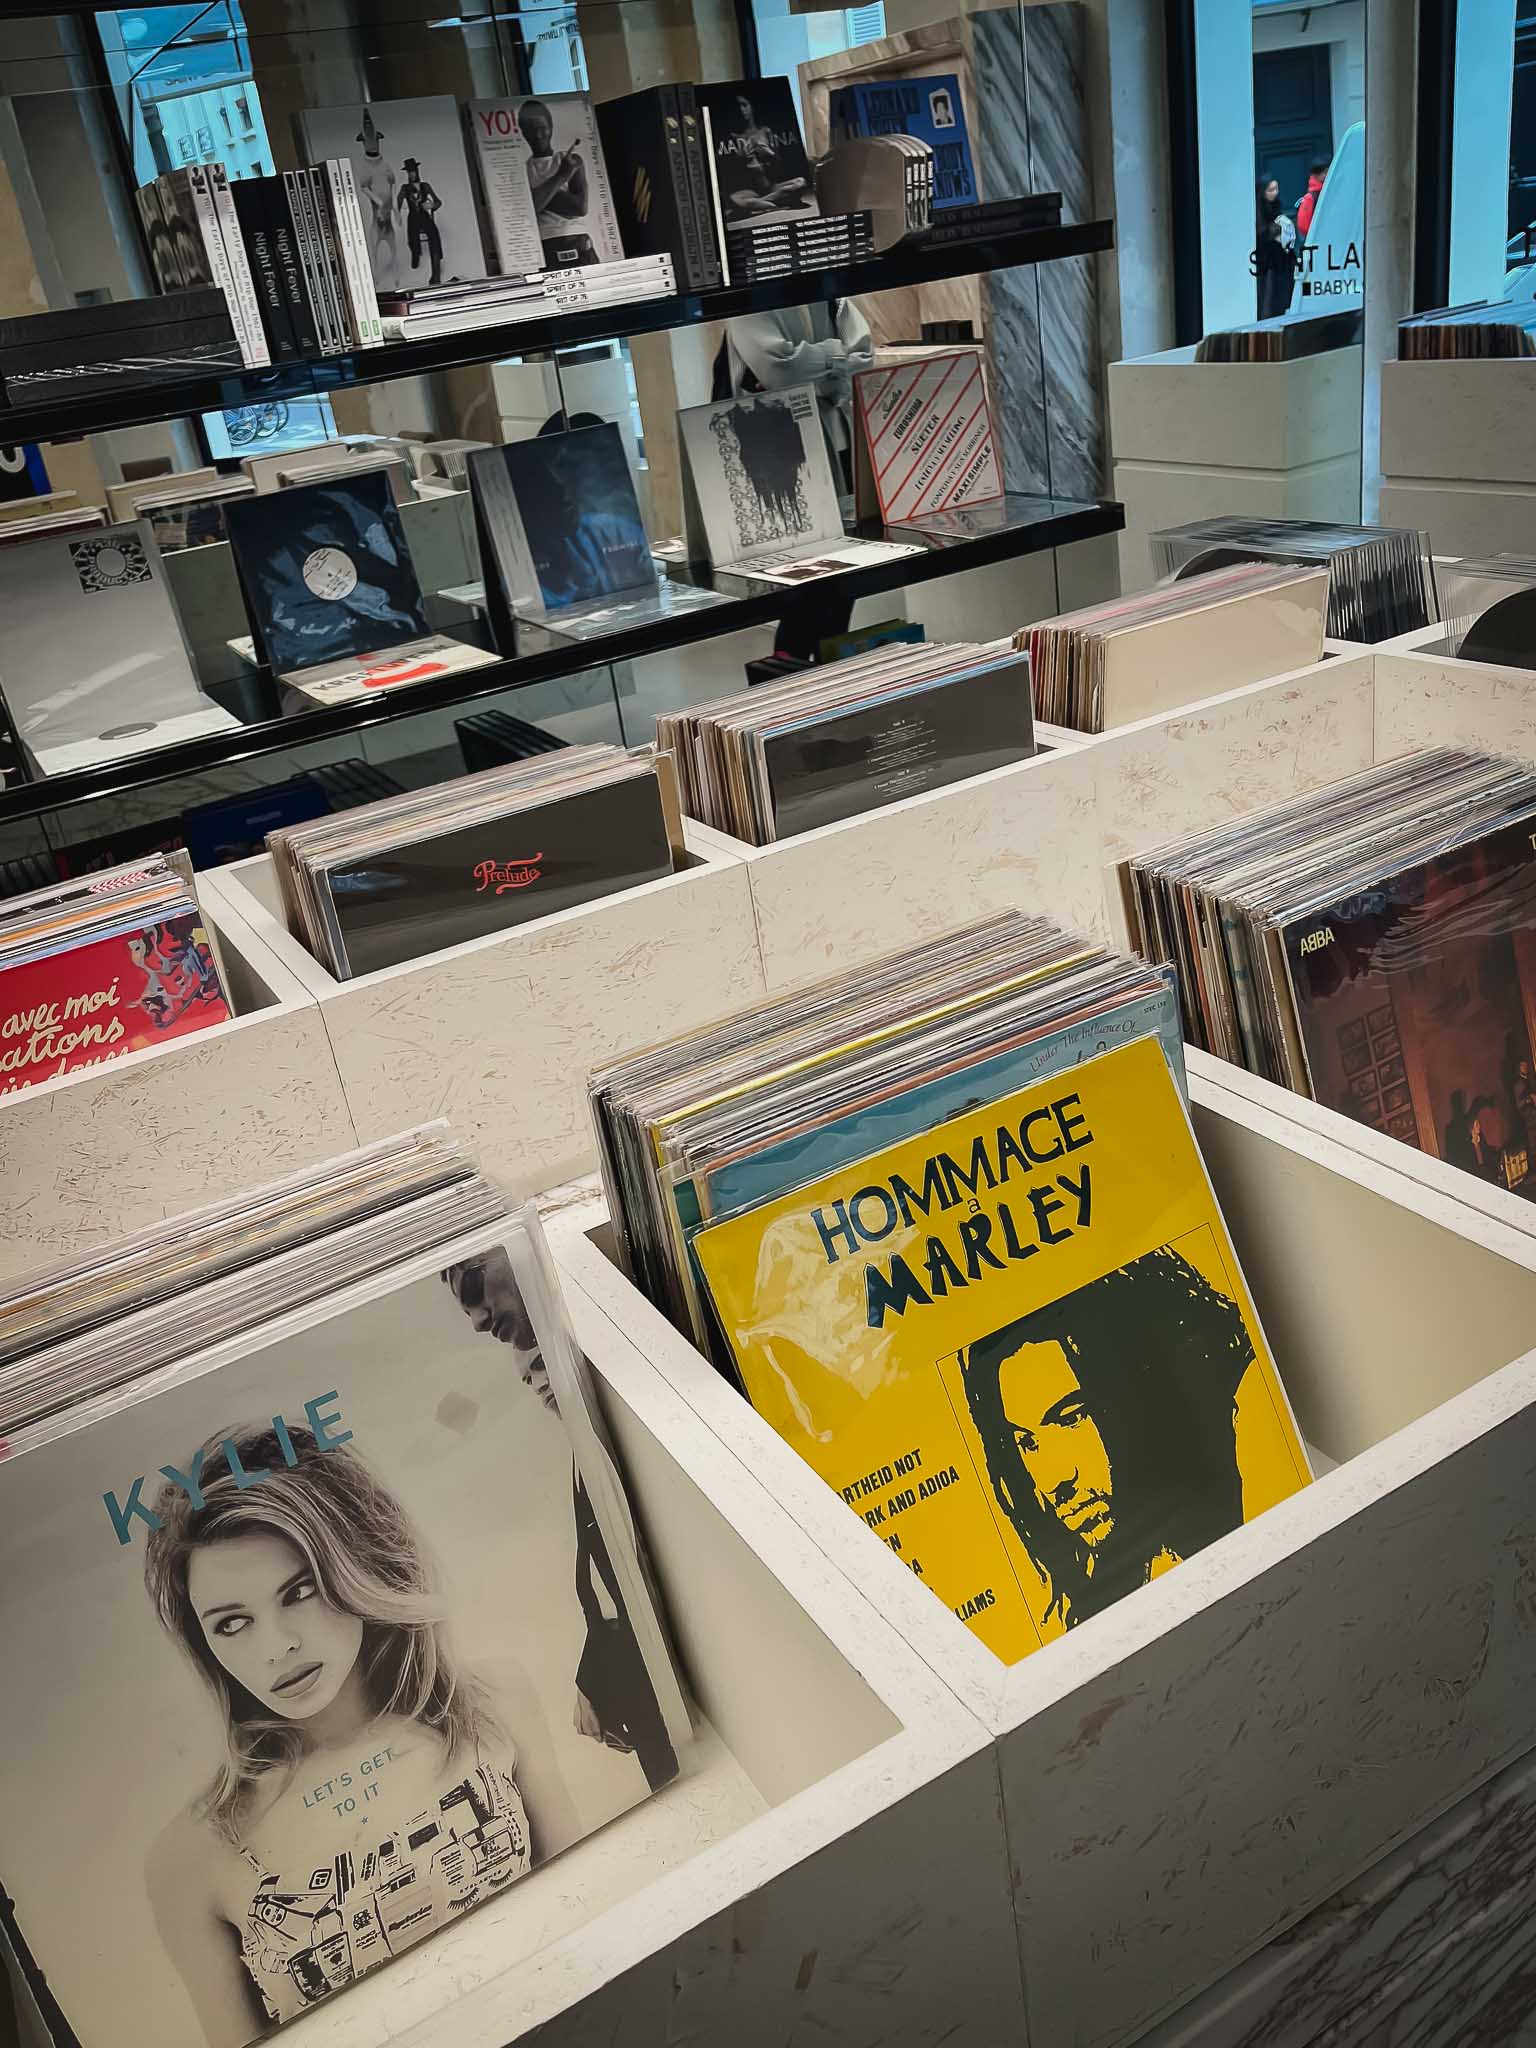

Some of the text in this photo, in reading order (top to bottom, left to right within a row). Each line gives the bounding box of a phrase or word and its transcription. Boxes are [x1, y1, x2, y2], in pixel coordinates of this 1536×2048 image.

[478, 110, 519, 136] YO!
[255, 232, 281, 308] Night Fever
[277, 228, 301, 304] Night Fever
[473, 852, 543, 895] Prelude
[1301, 927, 1335, 957] ABBA
[2, 977, 120, 1038] avec moi
[1030, 1045, 1058, 1072] Under
[1060, 1032, 1079, 1049] The
[1081, 1022, 1121, 1040] Influence
[810, 1093, 1095, 1265] HOMMAGE
[863, 1163, 1092, 1329] MARLEY
[103, 1390, 353, 1545] KYLIE
[894, 1448, 922, 1477] NOT
[860, 1465, 960, 1529] RK AND ADIOA
[302, 1747, 394, 1809] LET'S GET
[333, 1782, 381, 1818] TO IT
